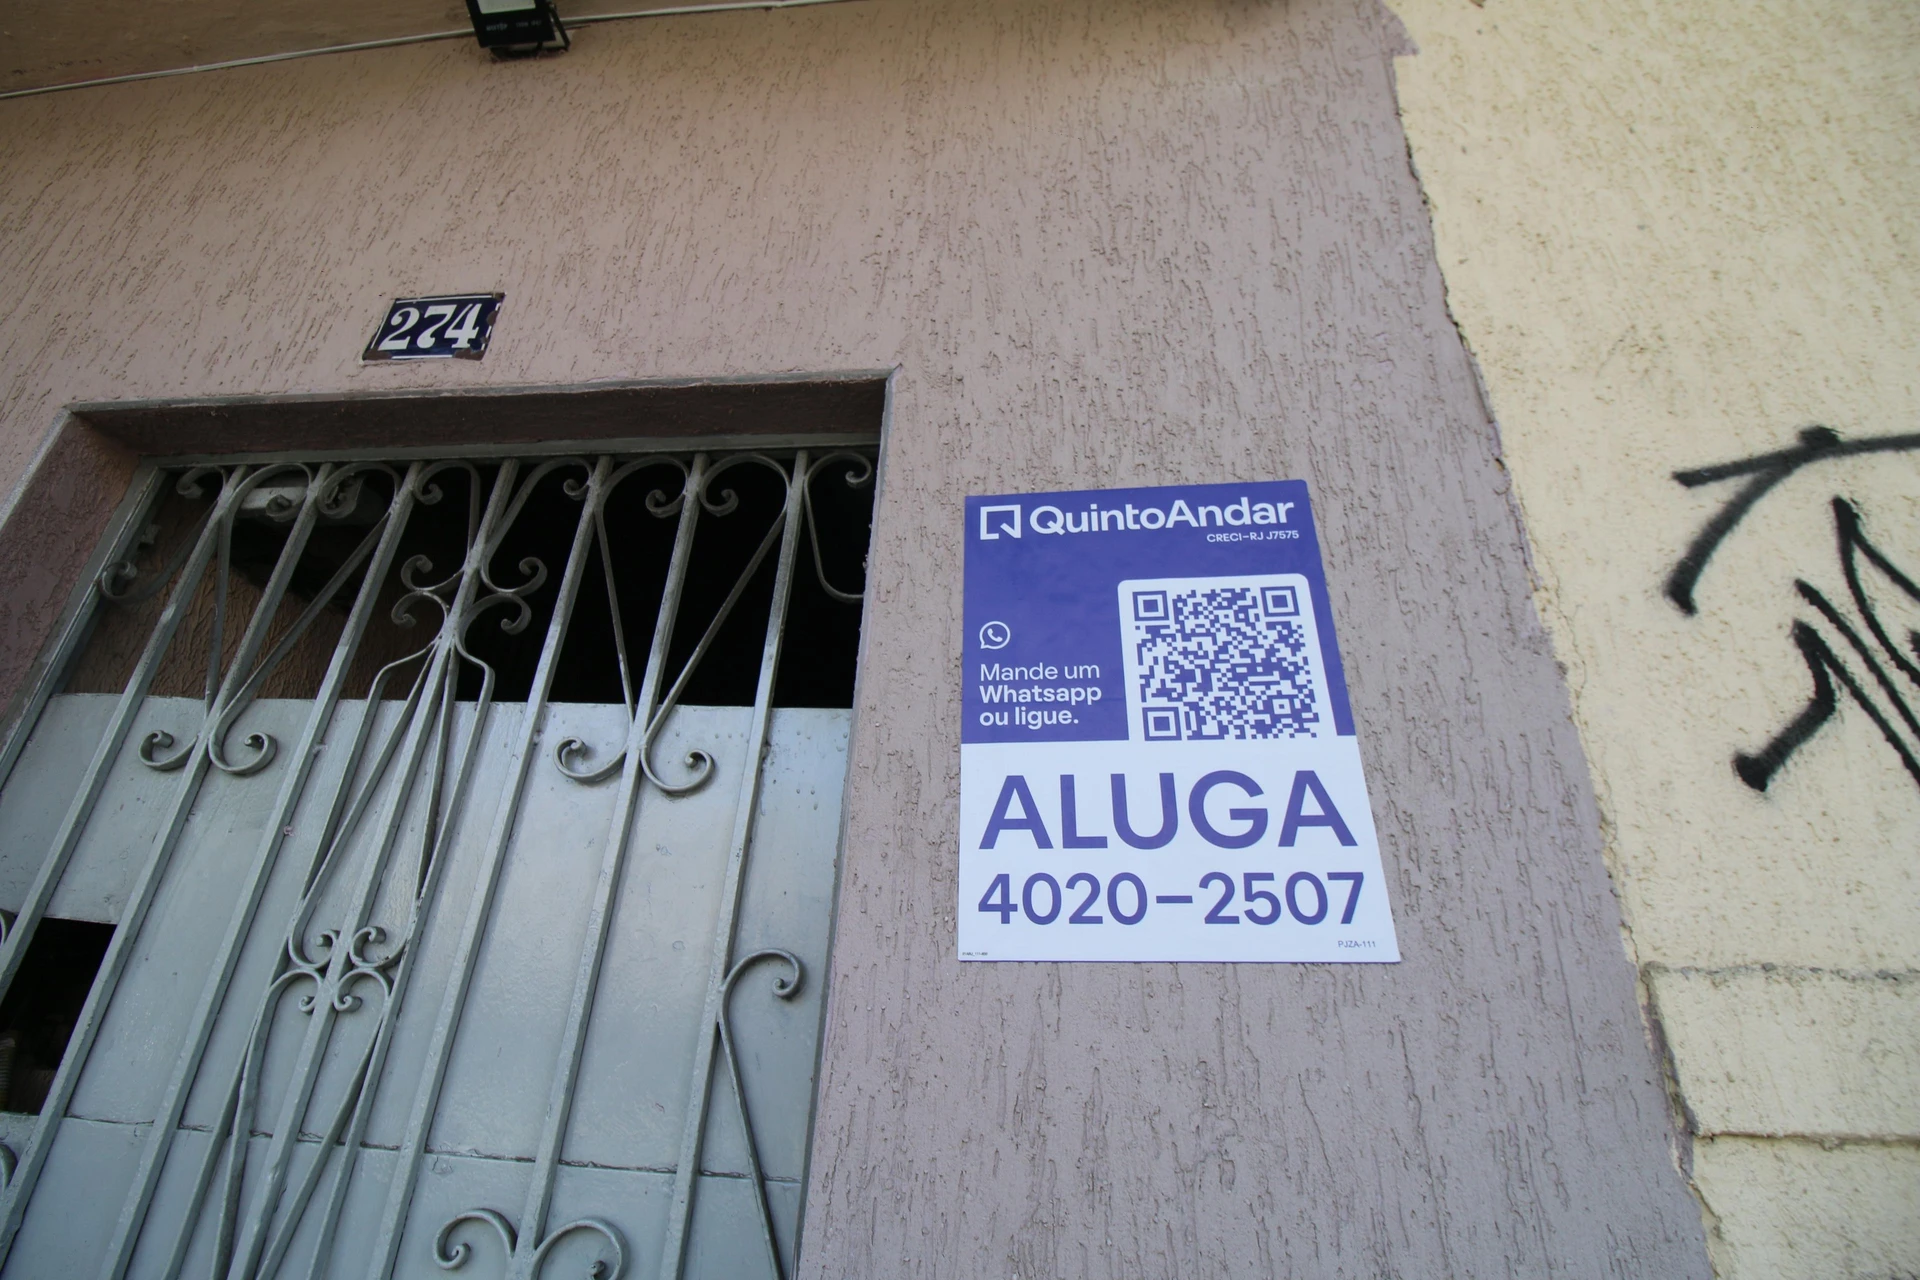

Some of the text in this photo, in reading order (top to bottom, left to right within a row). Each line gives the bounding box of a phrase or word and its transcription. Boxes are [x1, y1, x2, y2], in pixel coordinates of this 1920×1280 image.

[378, 303, 482, 351] 274
[1029, 497, 1294, 535] QuintoAndar
[1206, 530, 1300, 543] CRECI-RJ J7575
[980, 662, 1100, 681] Mande um
[979, 685, 1102, 705] Whatsapp
[979, 706, 1079, 730] ou ligue.
[979, 770, 1358, 850] ALUGA
[978, 871, 1365, 925] 4020-2507
[1337, 940, 1376, 948] PJZA-111
